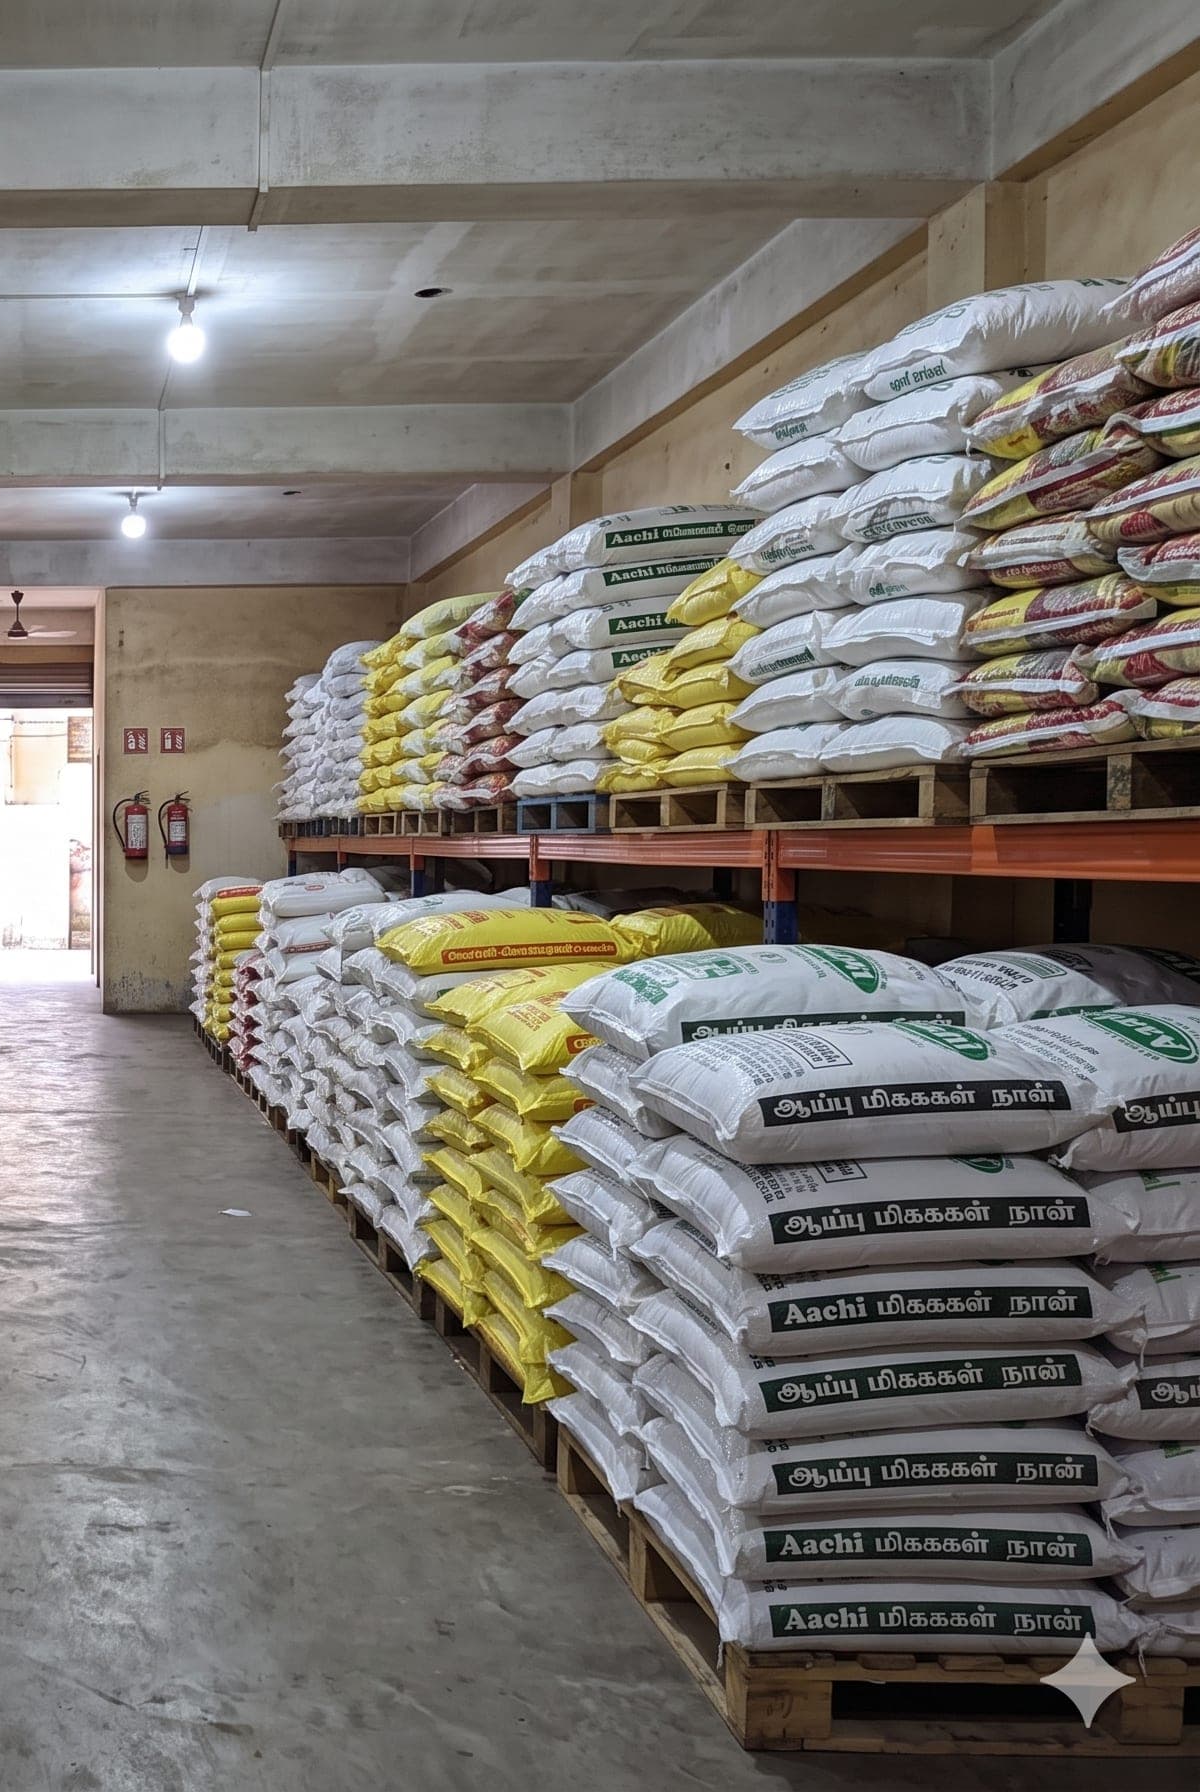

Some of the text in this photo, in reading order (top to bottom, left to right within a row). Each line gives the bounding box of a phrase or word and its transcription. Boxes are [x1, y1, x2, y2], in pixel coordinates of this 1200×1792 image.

[610, 528, 659, 545] Aachi
[609, 567, 653, 582] Aachi
[615, 615, 663, 630] Aachi
[773, 1093, 854, 1118] ஆய்பு
[783, 1209, 865, 1236] ஆய்பு
[1008, 1199, 1076, 1226] நான்
[783, 1297, 869, 1325] Aachi
[1008, 1288, 1078, 1317] நான்
[777, 1373, 859, 1402] ஆய்பு
[1001, 1357, 1067, 1387] நான்
[788, 1460, 870, 1488] ஆய்பு
[1015, 1454, 1085, 1483] நான்
[779, 1531, 864, 1555] Aachi
[1007, 1533, 1077, 1561] நான்
[784, 1607, 869, 1631] Aachi
[1013, 1605, 1082, 1635] நான்
